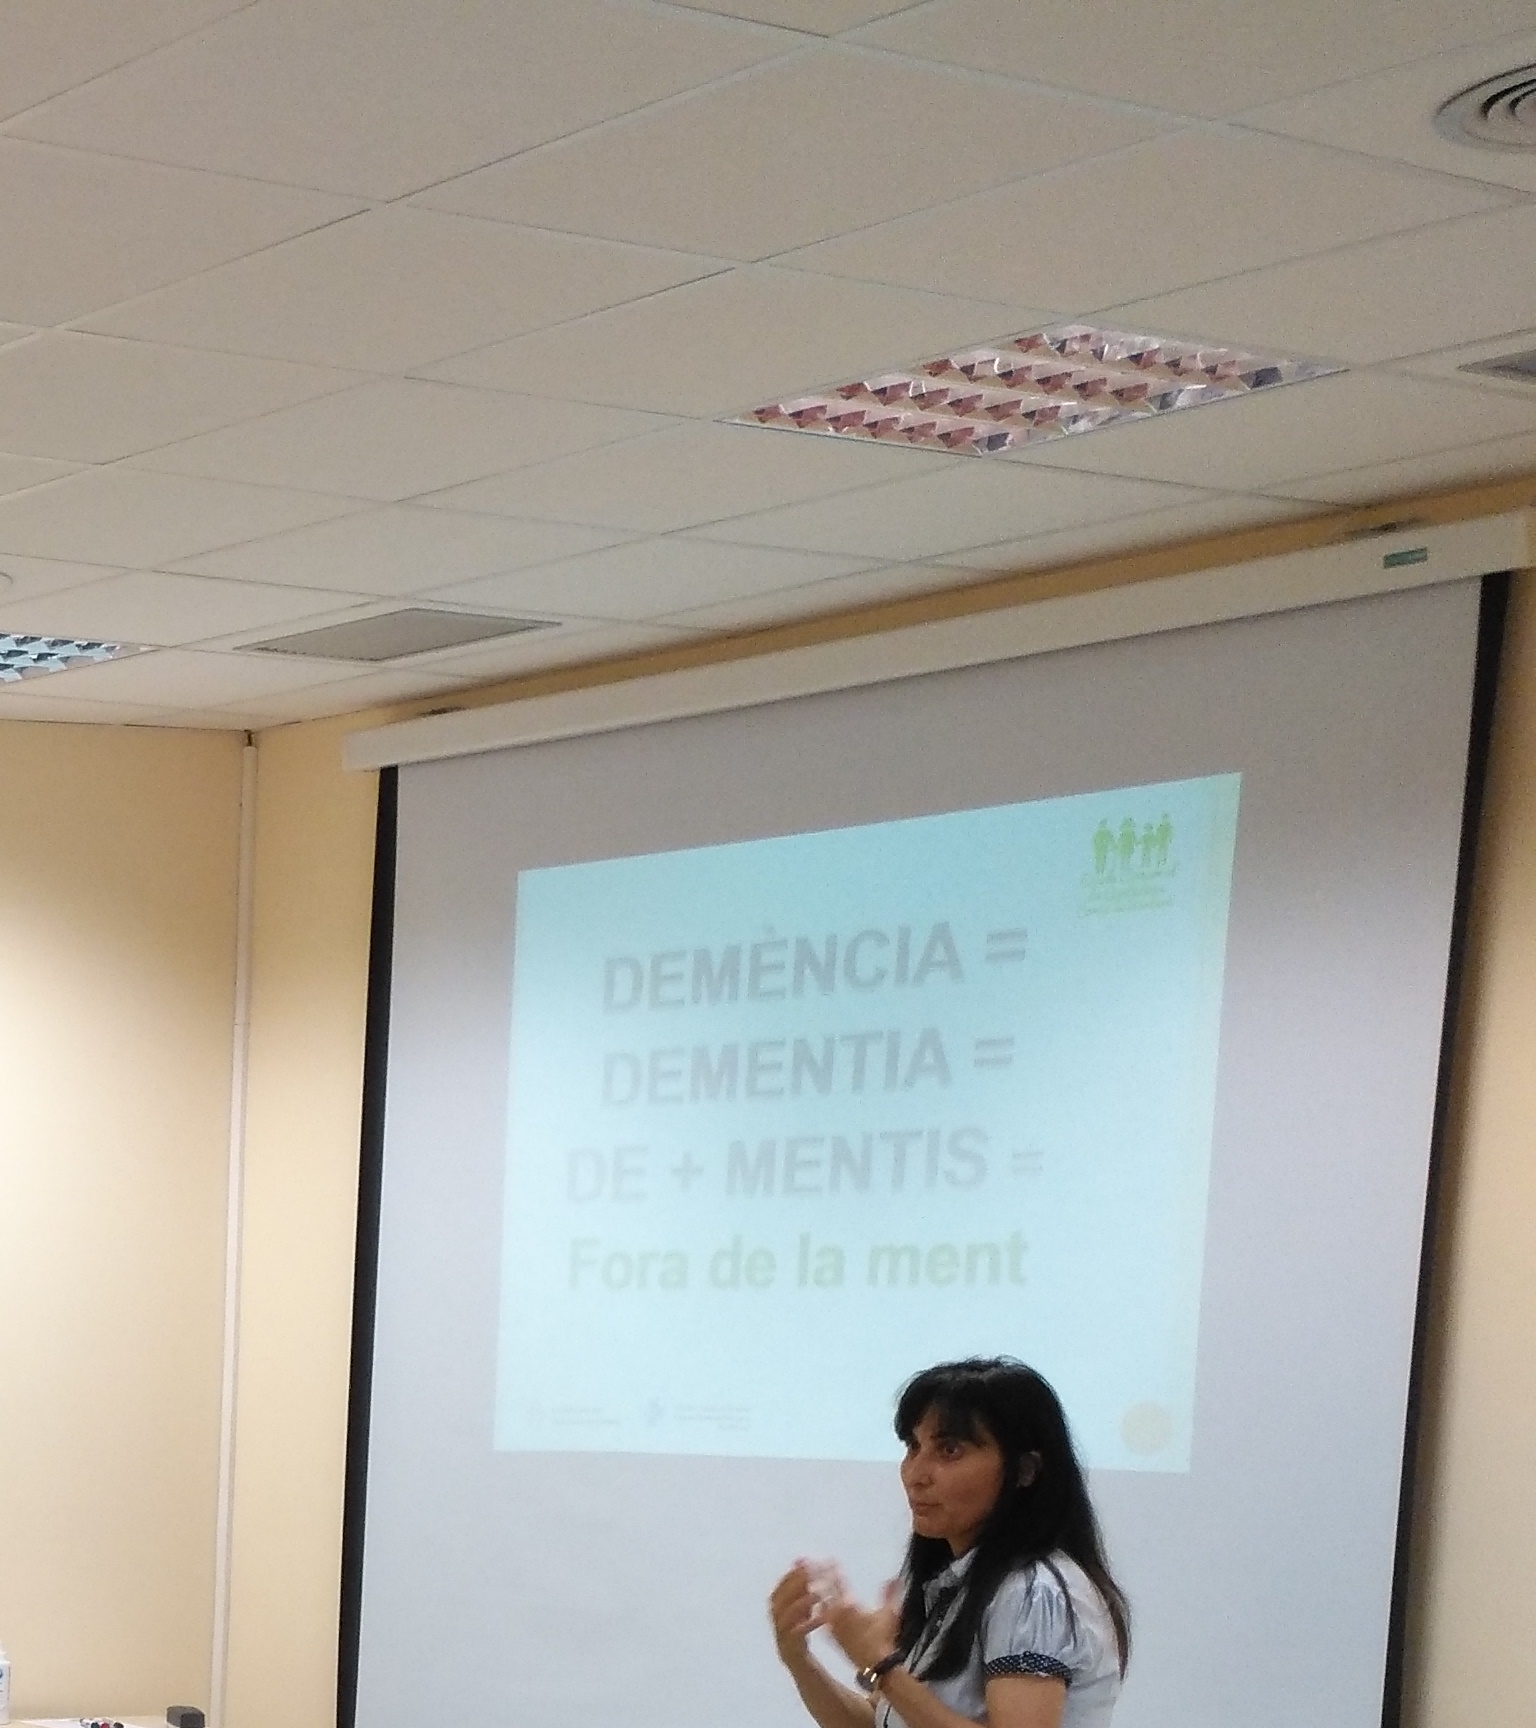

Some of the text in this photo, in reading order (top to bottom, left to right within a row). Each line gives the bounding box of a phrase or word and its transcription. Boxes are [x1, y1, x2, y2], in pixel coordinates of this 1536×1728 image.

[602, 921, 965, 1013] DEMÈNCIA
[600, 1026, 953, 1109] DEMENTIA
[566, 1144, 649, 1204] DE
[725, 1125, 990, 1198] MENTIS
[568, 1229, 1029, 1291] Fora de la ment
